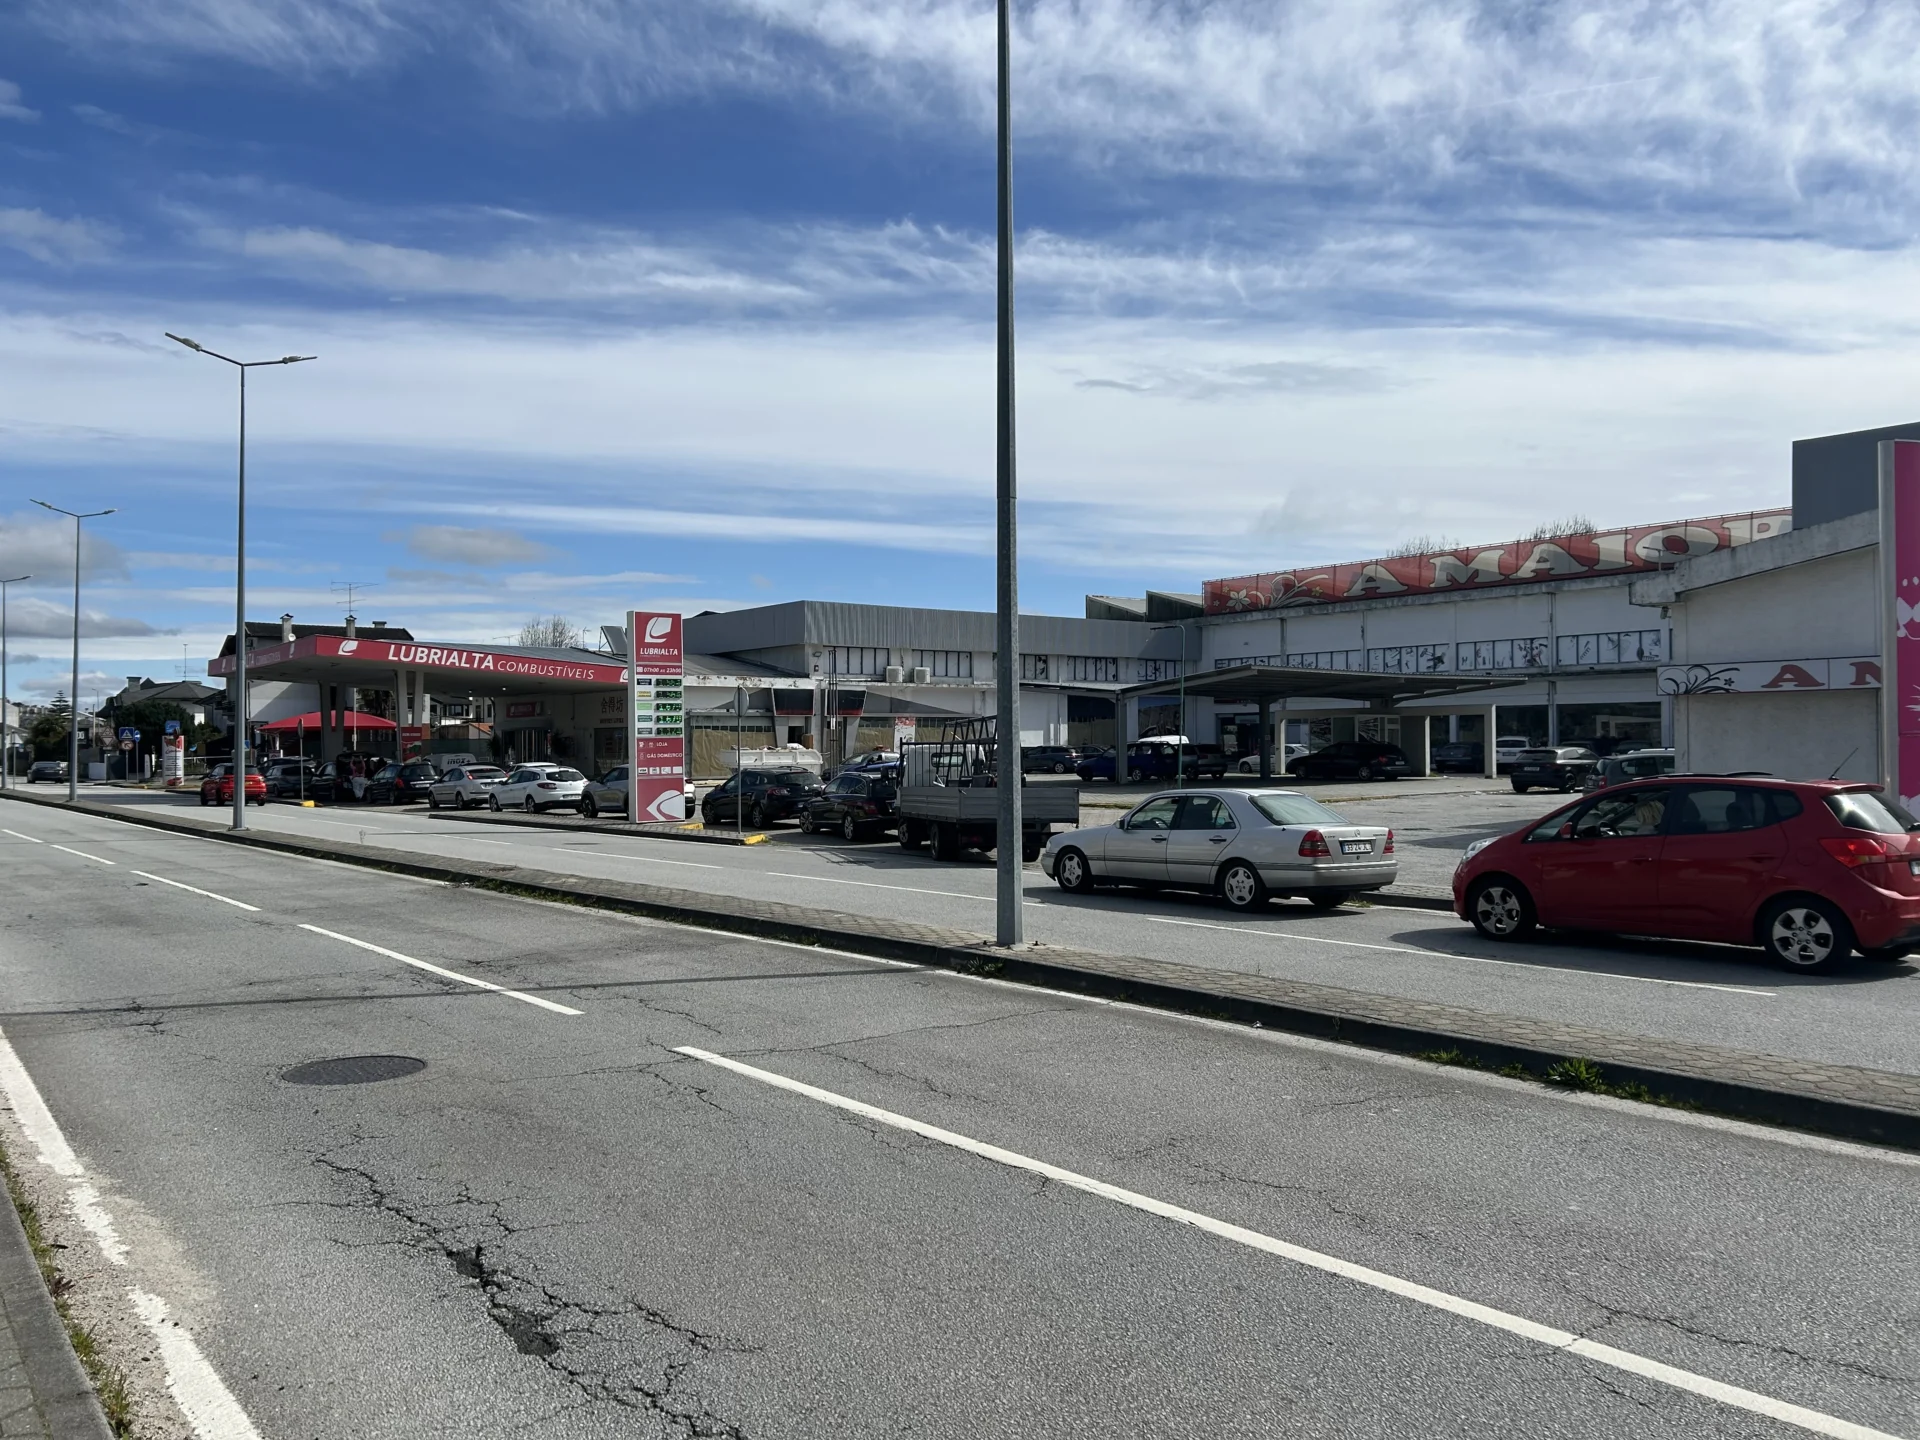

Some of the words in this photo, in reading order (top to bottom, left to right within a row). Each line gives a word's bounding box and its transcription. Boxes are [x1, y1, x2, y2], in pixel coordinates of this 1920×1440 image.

[1343, 565, 1408, 597] A
[388, 644, 494, 670] LUBRIALTA
[497, 660, 595, 680] COMBUSTÍVEIS
[640, 647, 678, 656] LUBRIALTA
